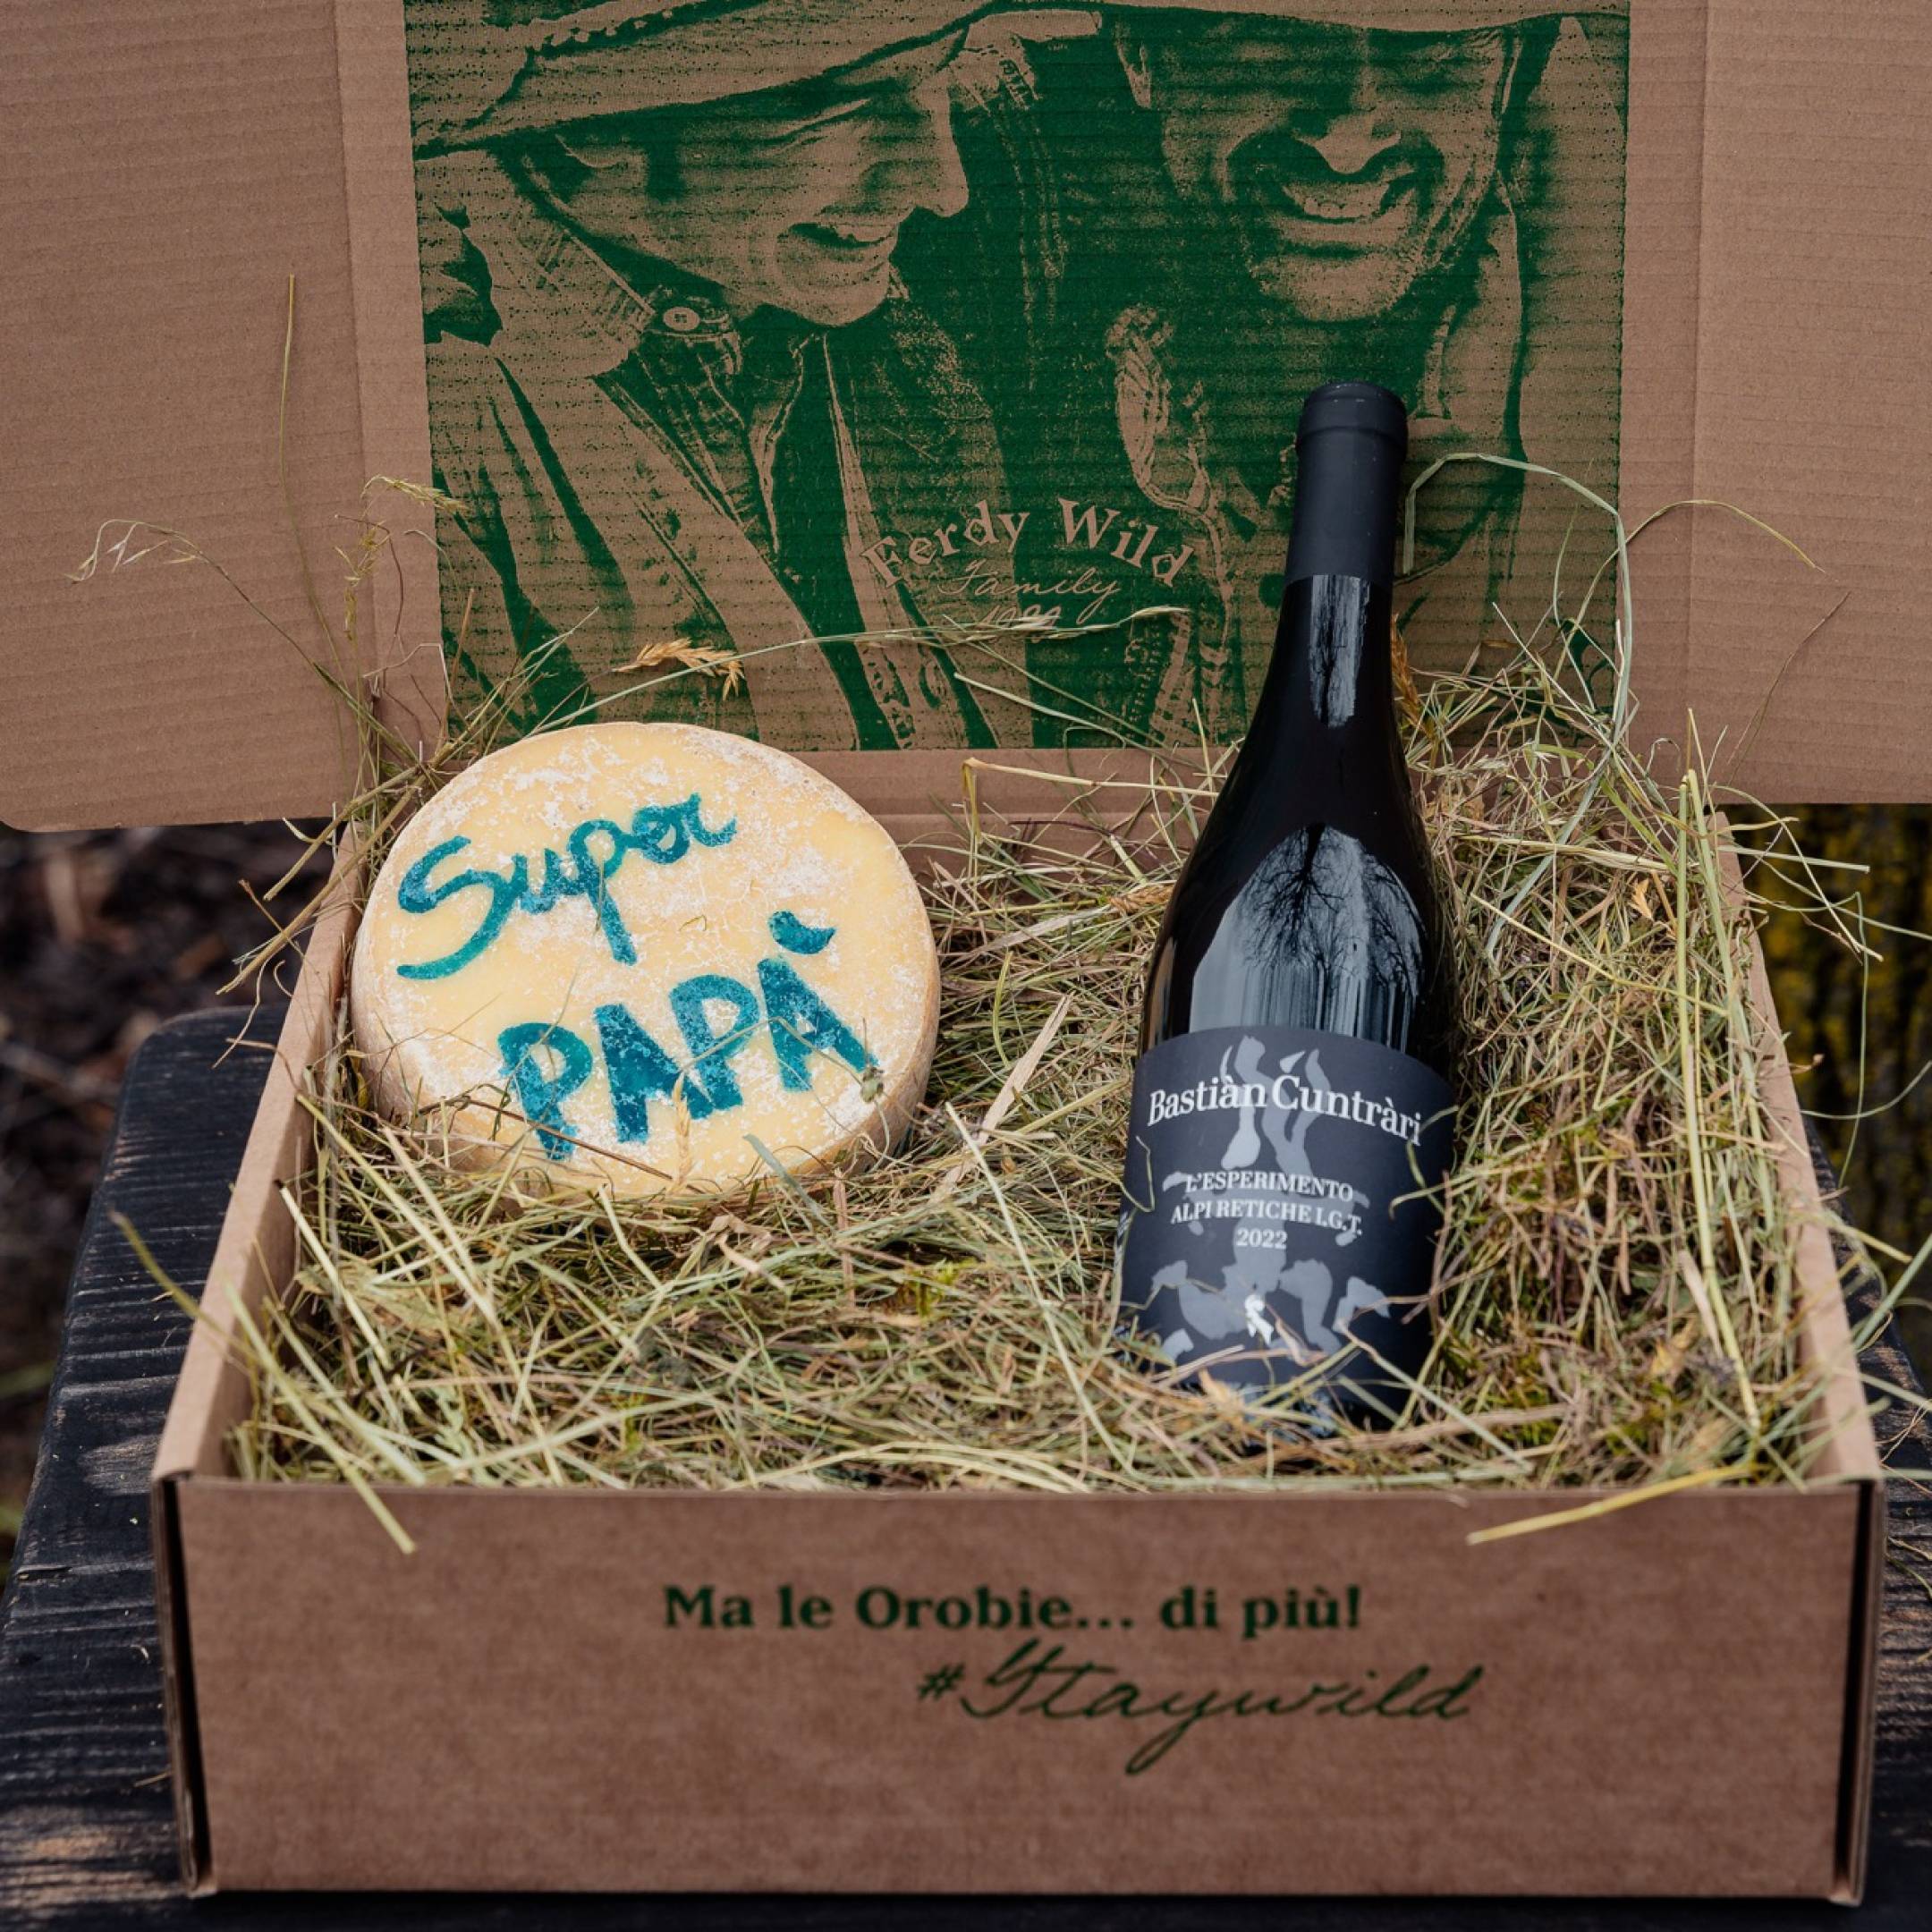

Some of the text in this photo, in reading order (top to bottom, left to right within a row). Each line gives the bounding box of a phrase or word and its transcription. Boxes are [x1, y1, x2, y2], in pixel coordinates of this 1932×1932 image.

[860, 497, 1194, 588] Ferdy Wild
[937, 558, 1122, 625] Family
[497, 910, 878, 1162] PAPÀ
[1148, 1074, 1421, 1146] Bastiàn Cuntràri
[1170, 1199, 1363, 1235] ALPI RETICHE I.G.T.
[1185, 1170, 1353, 1202] L'ESPERIMENTO
[1236, 1227, 1288, 1250] 2022
[664, 1584, 754, 1629] Ma
[777, 1584, 834, 1630] le
[1160, 1585, 1218, 1630] di
[1242, 1584, 1360, 1640] più!
[917, 1638, 1483, 1775] #Staywild
